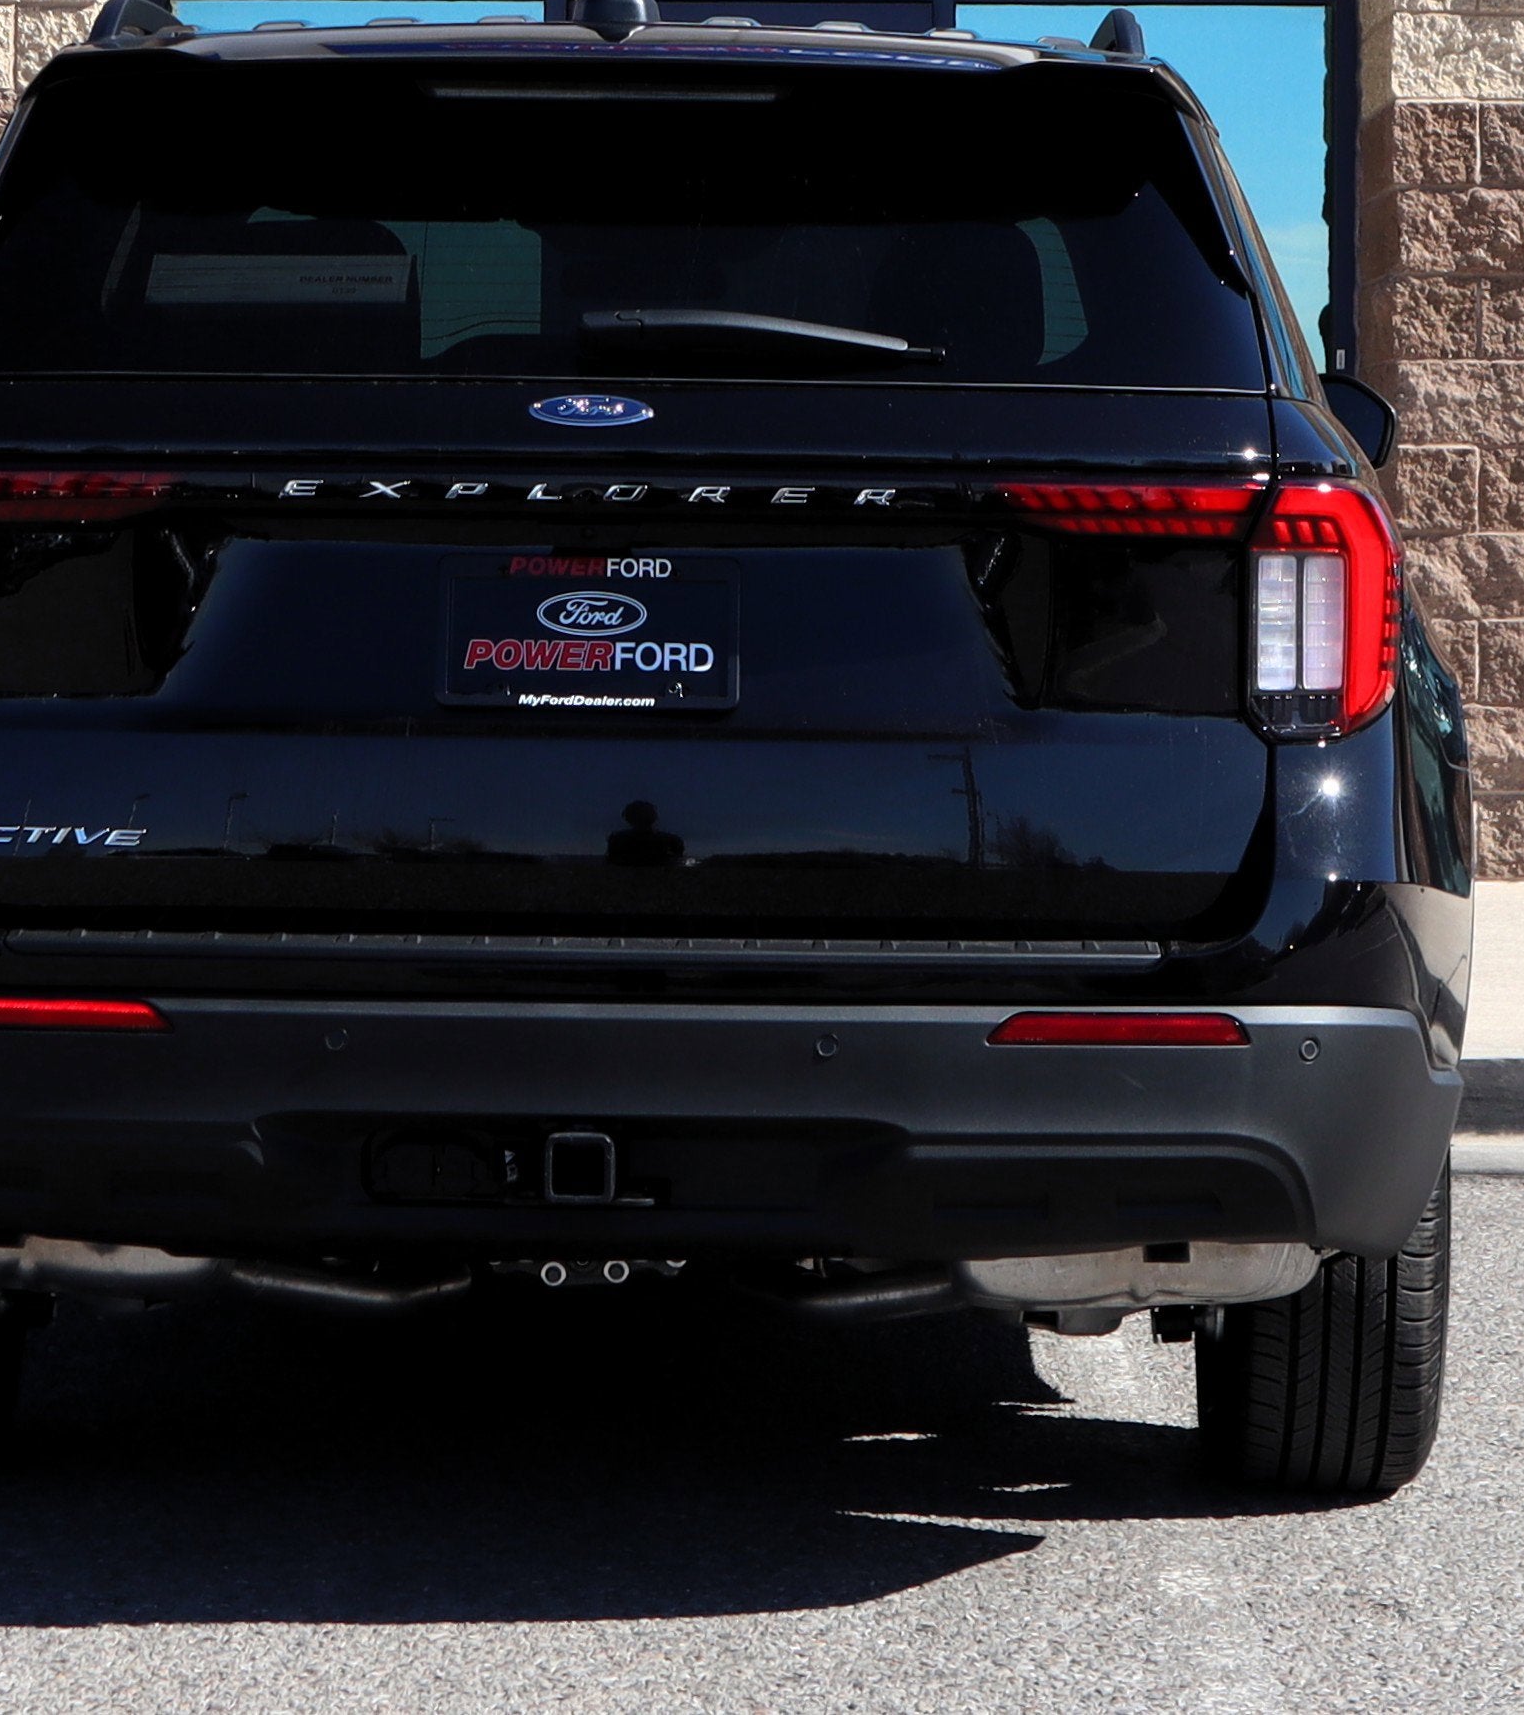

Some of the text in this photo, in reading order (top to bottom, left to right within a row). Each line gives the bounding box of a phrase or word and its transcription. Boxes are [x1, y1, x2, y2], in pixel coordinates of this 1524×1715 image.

[279, 478, 897, 506] EXPLORER
[558, 599, 624, 628] Ford
[518, 694, 655, 707] MyFordDealer.com
